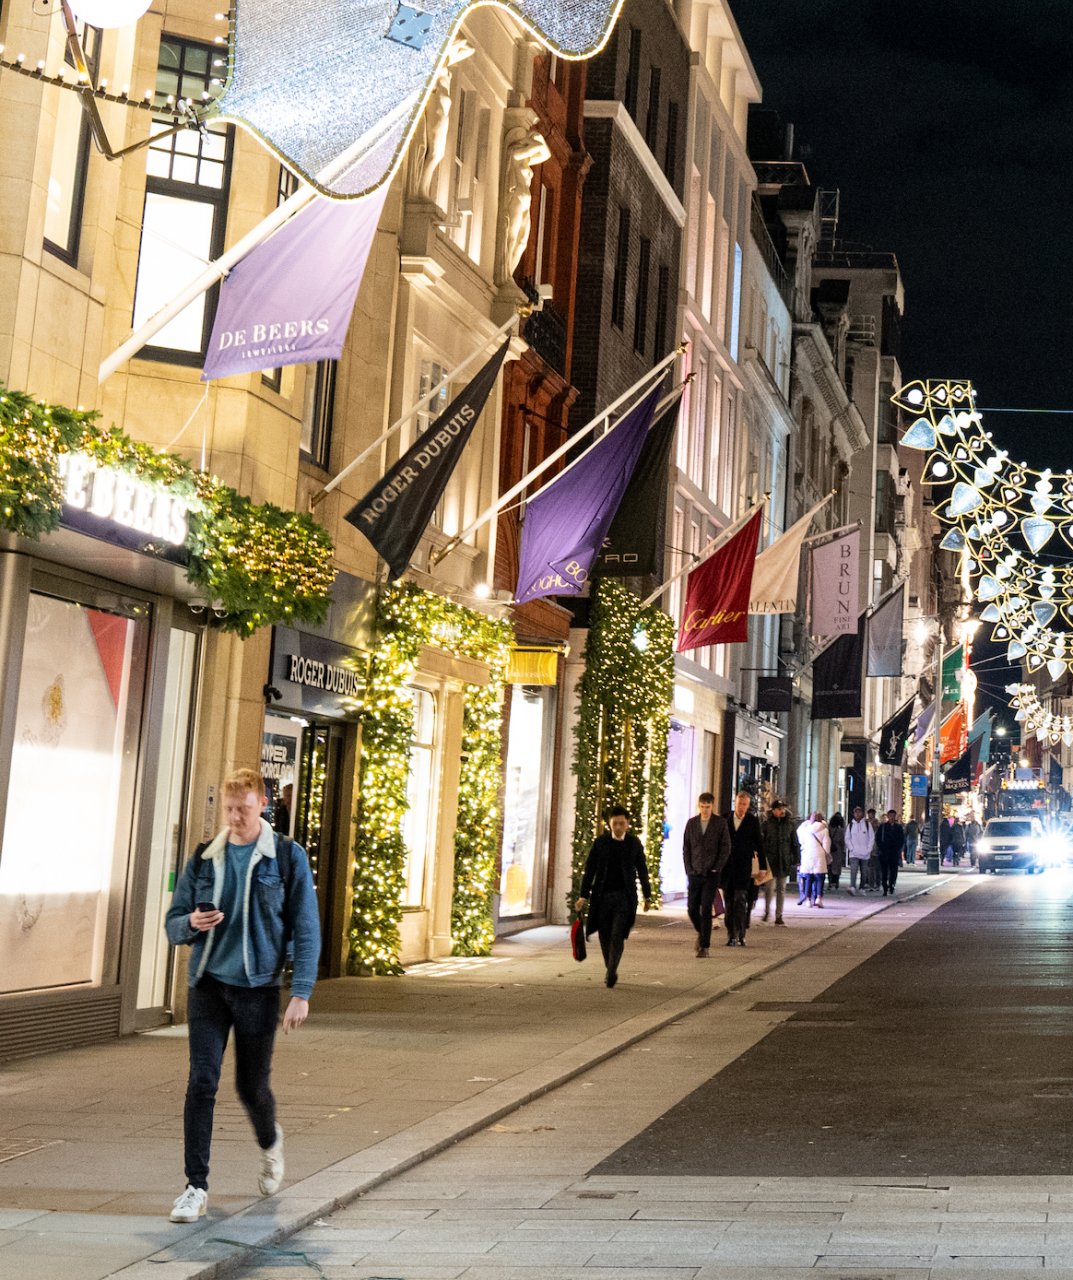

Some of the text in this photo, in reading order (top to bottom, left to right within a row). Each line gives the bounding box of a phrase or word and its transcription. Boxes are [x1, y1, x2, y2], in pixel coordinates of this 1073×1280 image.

[219, 318, 329, 350] DE BEERS
[361, 404, 475, 525] ROGER DUBUIS
[92, 466, 188, 545] BEERS
[838, 544, 851, 614] BRUN
[684, 609, 741, 632] Cartier
[749, 599, 796, 612] ALENTIN
[290, 655, 359, 697] ROGER DUBUIS
